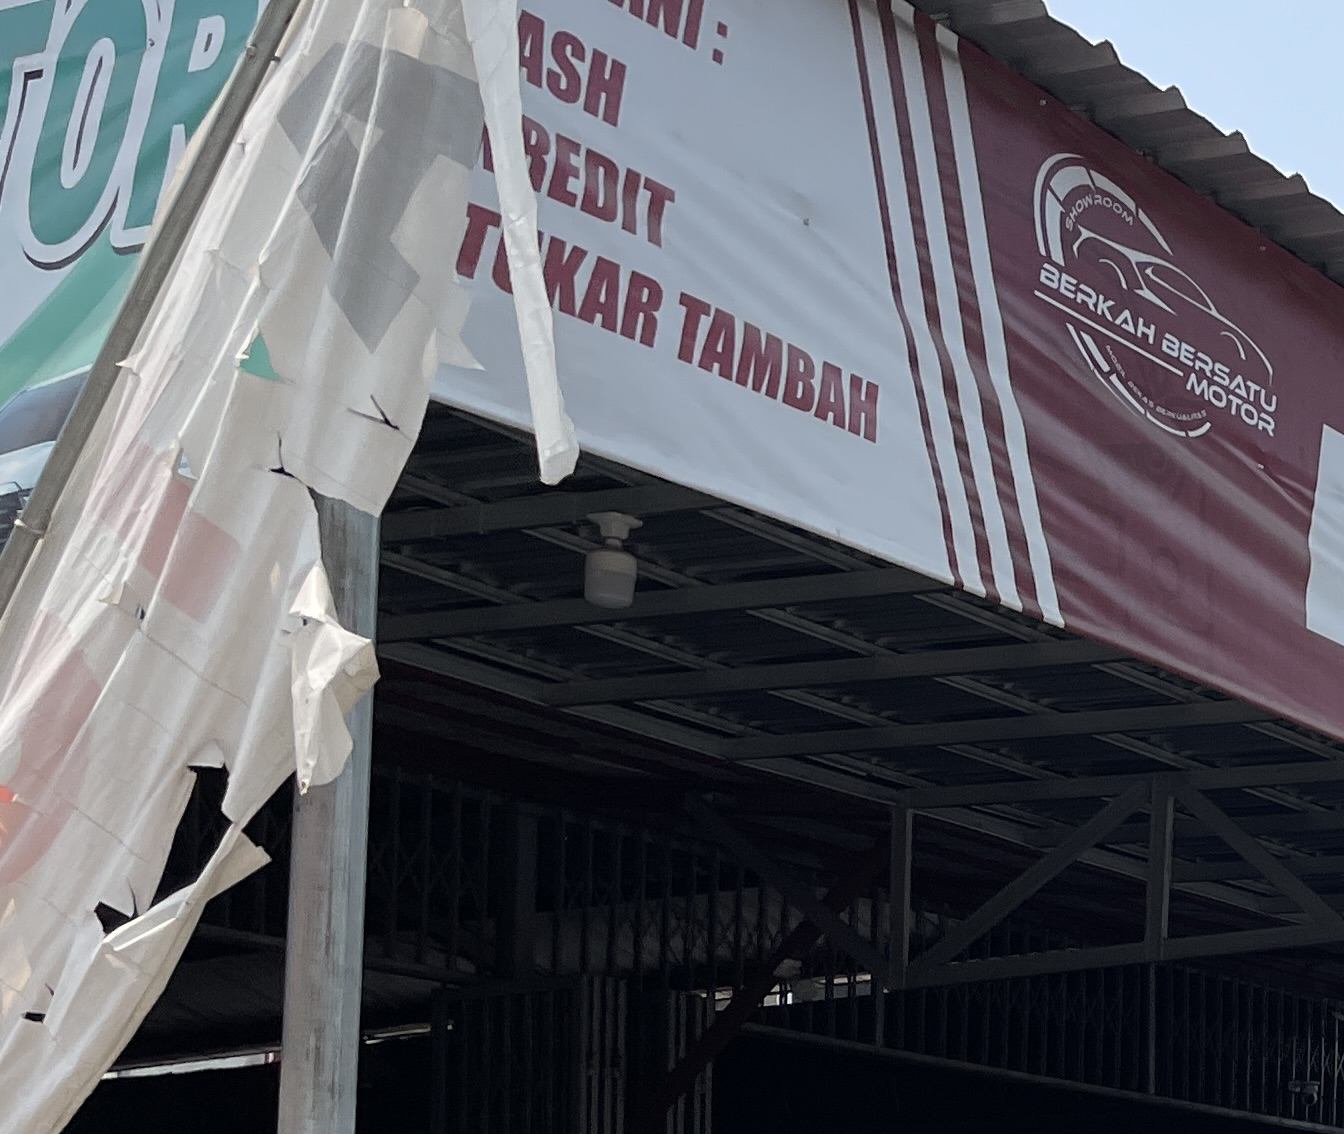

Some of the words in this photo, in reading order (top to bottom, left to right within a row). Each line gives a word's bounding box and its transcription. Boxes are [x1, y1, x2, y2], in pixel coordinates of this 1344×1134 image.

[518, 10, 627, 127] ASH
[1065, 194, 1134, 232] SHOWROOM
[678, 292, 880, 444] TAMBAH
[1040, 262, 1156, 344] BERKAH
[1161, 332, 1277, 413] BERSATU
[1186, 373, 1276, 437] MOTOR
